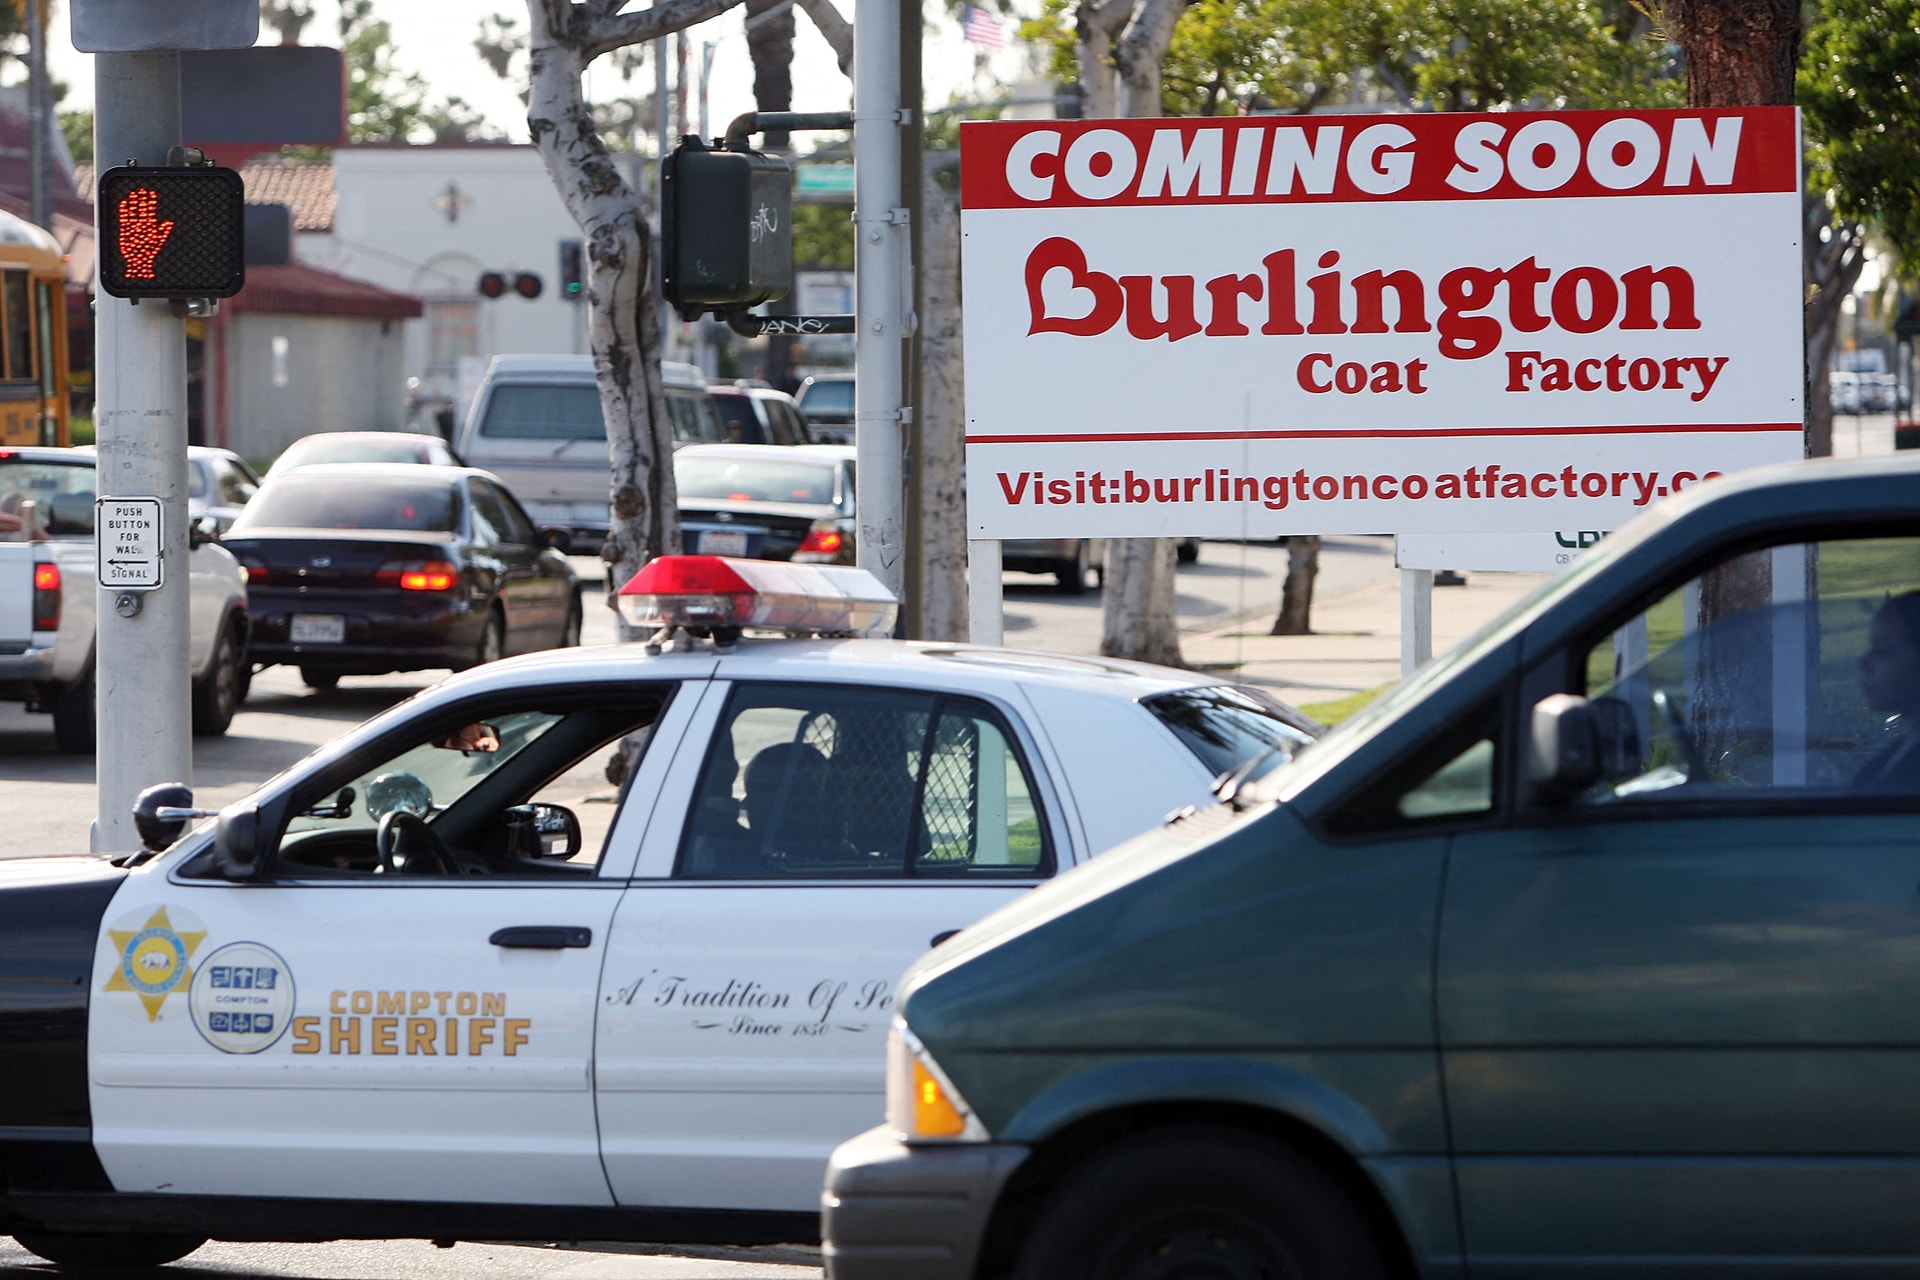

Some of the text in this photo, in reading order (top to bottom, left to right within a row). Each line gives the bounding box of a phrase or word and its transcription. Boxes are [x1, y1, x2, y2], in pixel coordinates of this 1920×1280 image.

[1005, 116, 1744, 202] COMING SOON
[1026, 237, 1702, 360] Burlington
[1298, 352, 1729, 402] Coat Factory
[116, 507, 143, 516] PUSH
[108, 520, 150, 529] BUTTON
[120, 533, 140, 541] FOR
[111, 569, 148, 579] SIGNAL
[216, 995, 269, 1005] COMPTON
[329, 990, 507, 1017] COMPTON
[606, 976, 645, 1007] A
[653, 976, 790, 1010] Tradition
[807, 977, 849, 1024] Of
[291, 1016, 532, 1057] SHERIFF
[727, 1014, 784, 1036] Since
